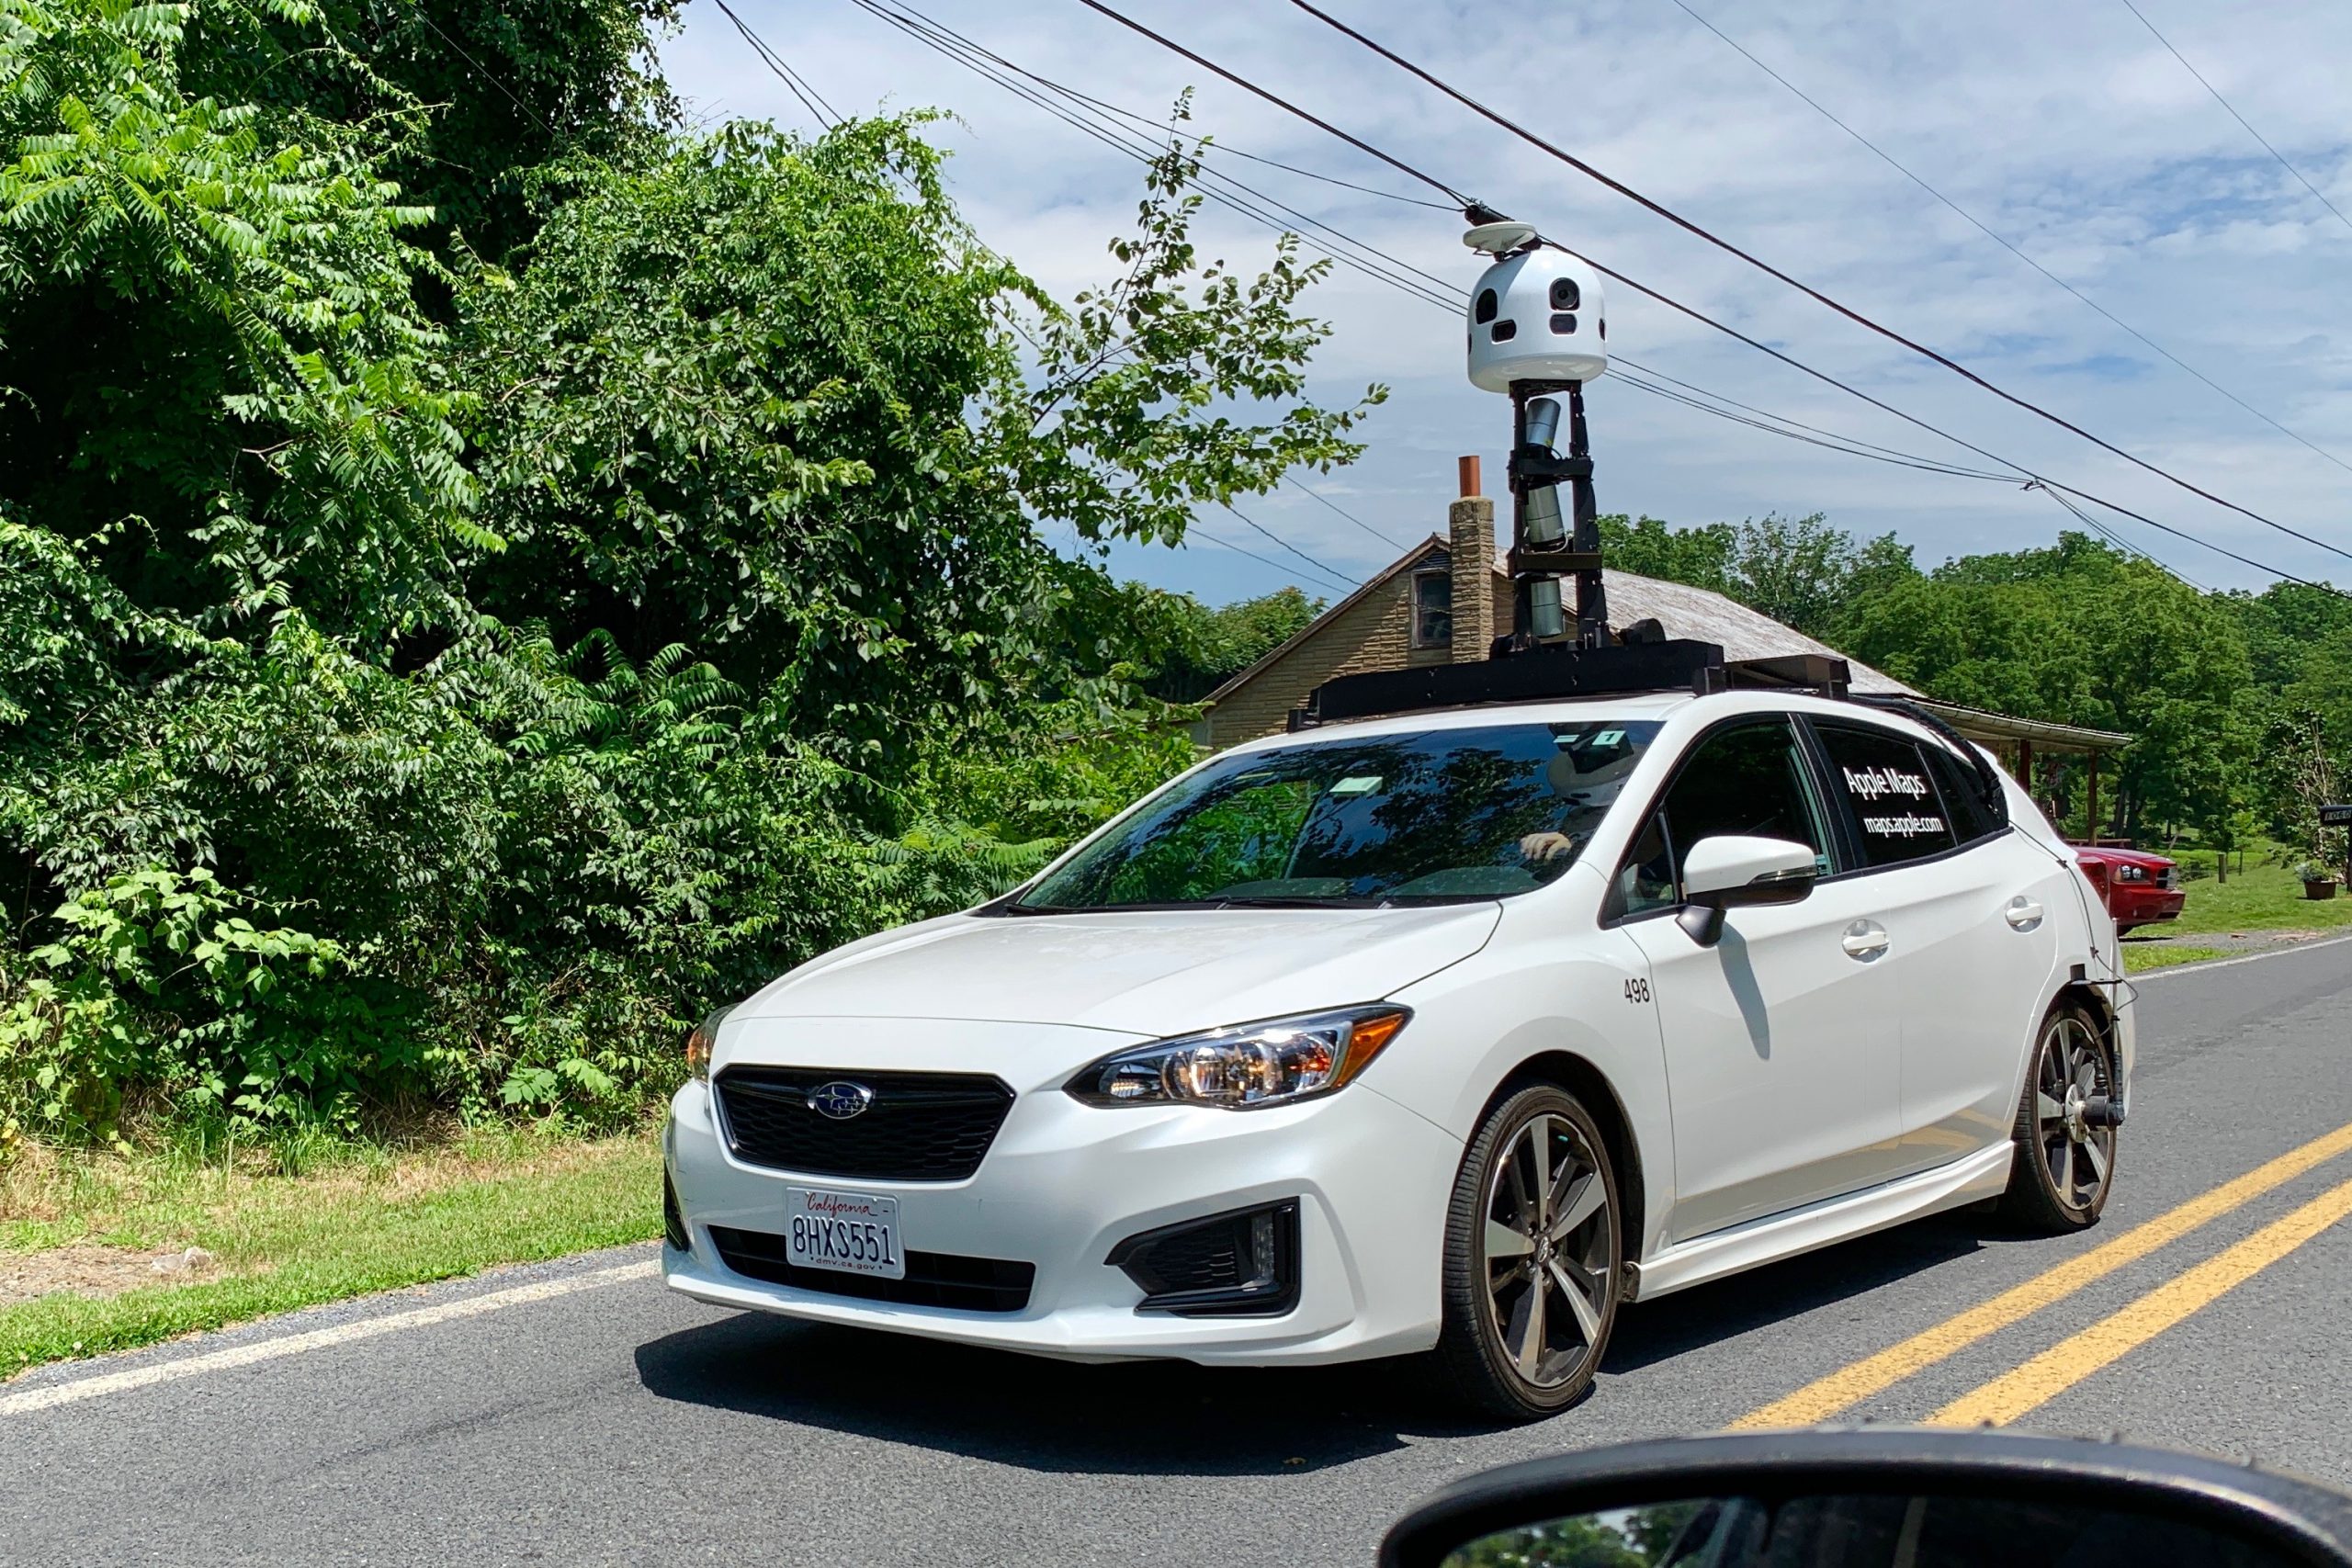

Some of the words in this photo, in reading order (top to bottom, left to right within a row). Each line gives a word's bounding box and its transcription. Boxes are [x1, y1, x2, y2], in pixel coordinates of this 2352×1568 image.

[1843, 766, 1891, 800] Apple
[1883, 768, 1927, 801] Maps
[1863, 811, 1945, 838] maps.apple.com
[1624, 977, 1650, 1004] 498
[807, 1192, 877, 1218] California
[793, 1215, 896, 1266] 8HXS551
[816, 1258, 876, 1269] dmv.ca.gov
